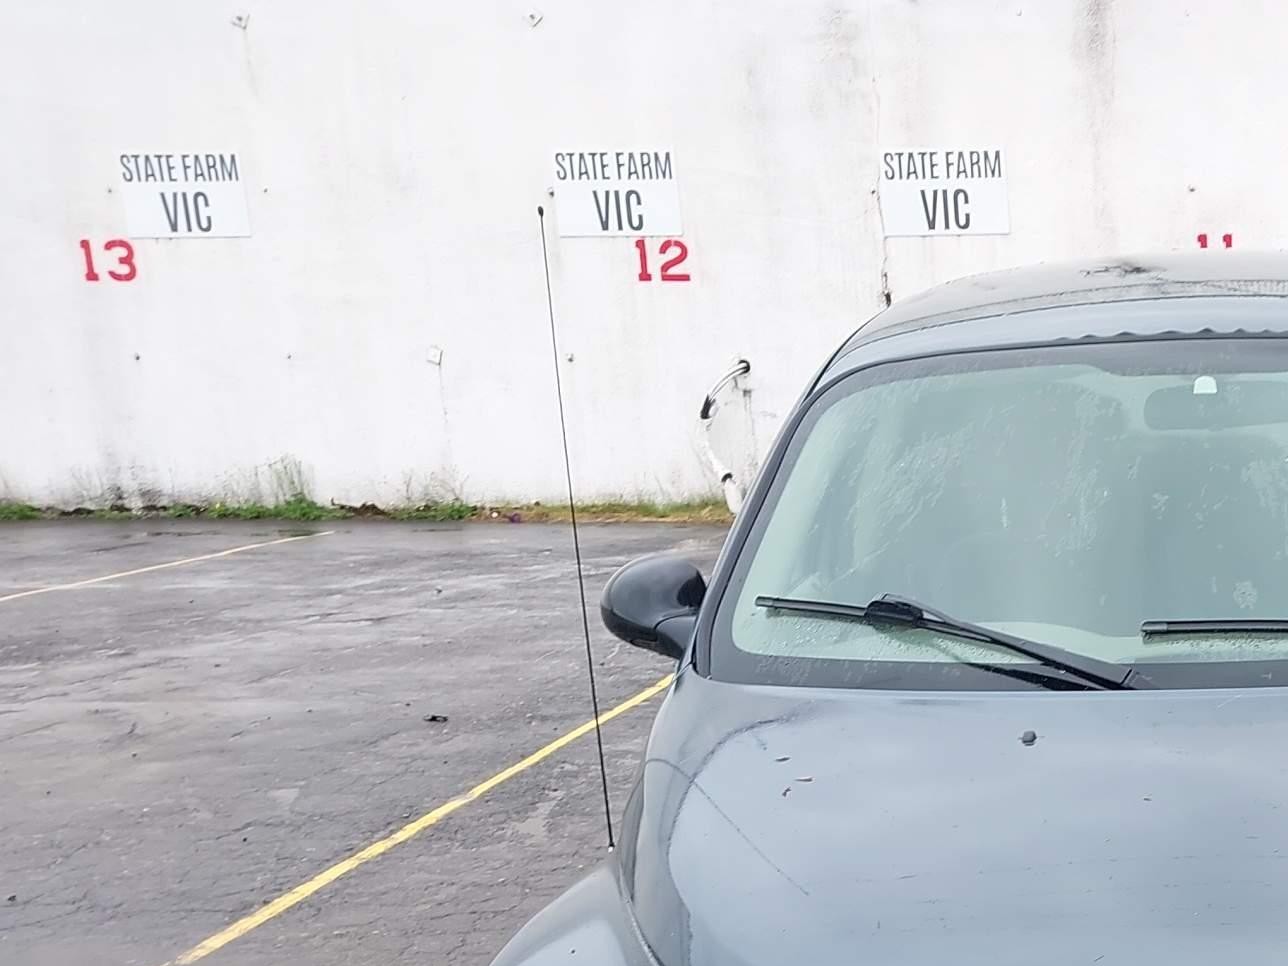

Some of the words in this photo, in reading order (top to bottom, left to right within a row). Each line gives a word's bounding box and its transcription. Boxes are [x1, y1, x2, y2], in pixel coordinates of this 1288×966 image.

[120, 154, 178, 184] STATE
[182, 154, 240, 183] FARM
[555, 152, 611, 182] STATE
[615, 151, 674, 181] FARM
[883, 151, 940, 181] STATE
[945, 150, 1003, 180] FARM
[160, 191, 213, 234] VIC
[592, 189, 645, 233] VIC
[920, 188, 972, 231] VIC
[79, 239, 139, 283] 13
[634, 239, 691, 283] 12
